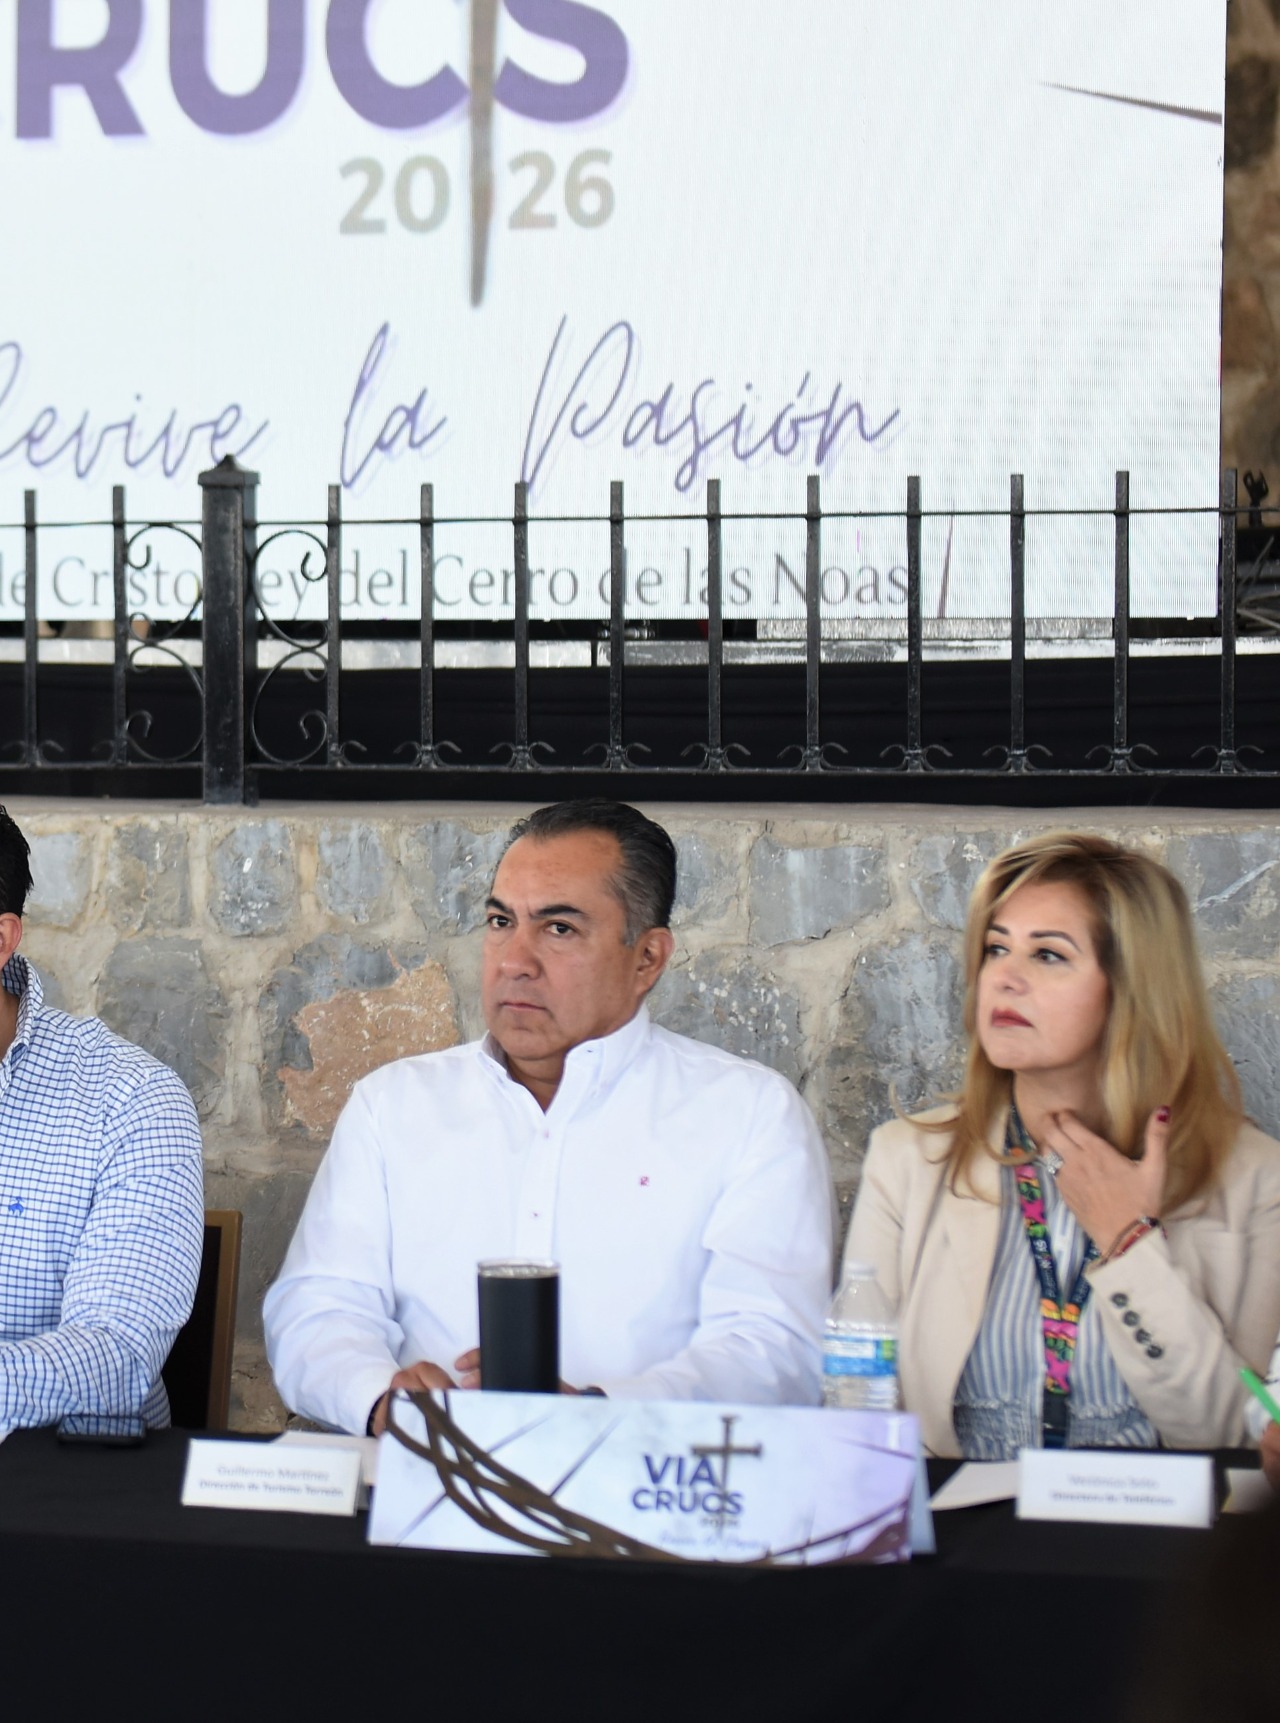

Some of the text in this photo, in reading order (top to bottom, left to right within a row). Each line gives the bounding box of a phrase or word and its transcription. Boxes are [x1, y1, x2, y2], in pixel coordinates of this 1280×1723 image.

[339, 149, 615, 235] 2026
[339, 322, 447, 488] la
[522, 313, 899, 492] Pasión
[52, 556, 202, 608] Crsto
[772, 552, 911, 606] Noas
[643, 1454, 718, 1487] VIA
